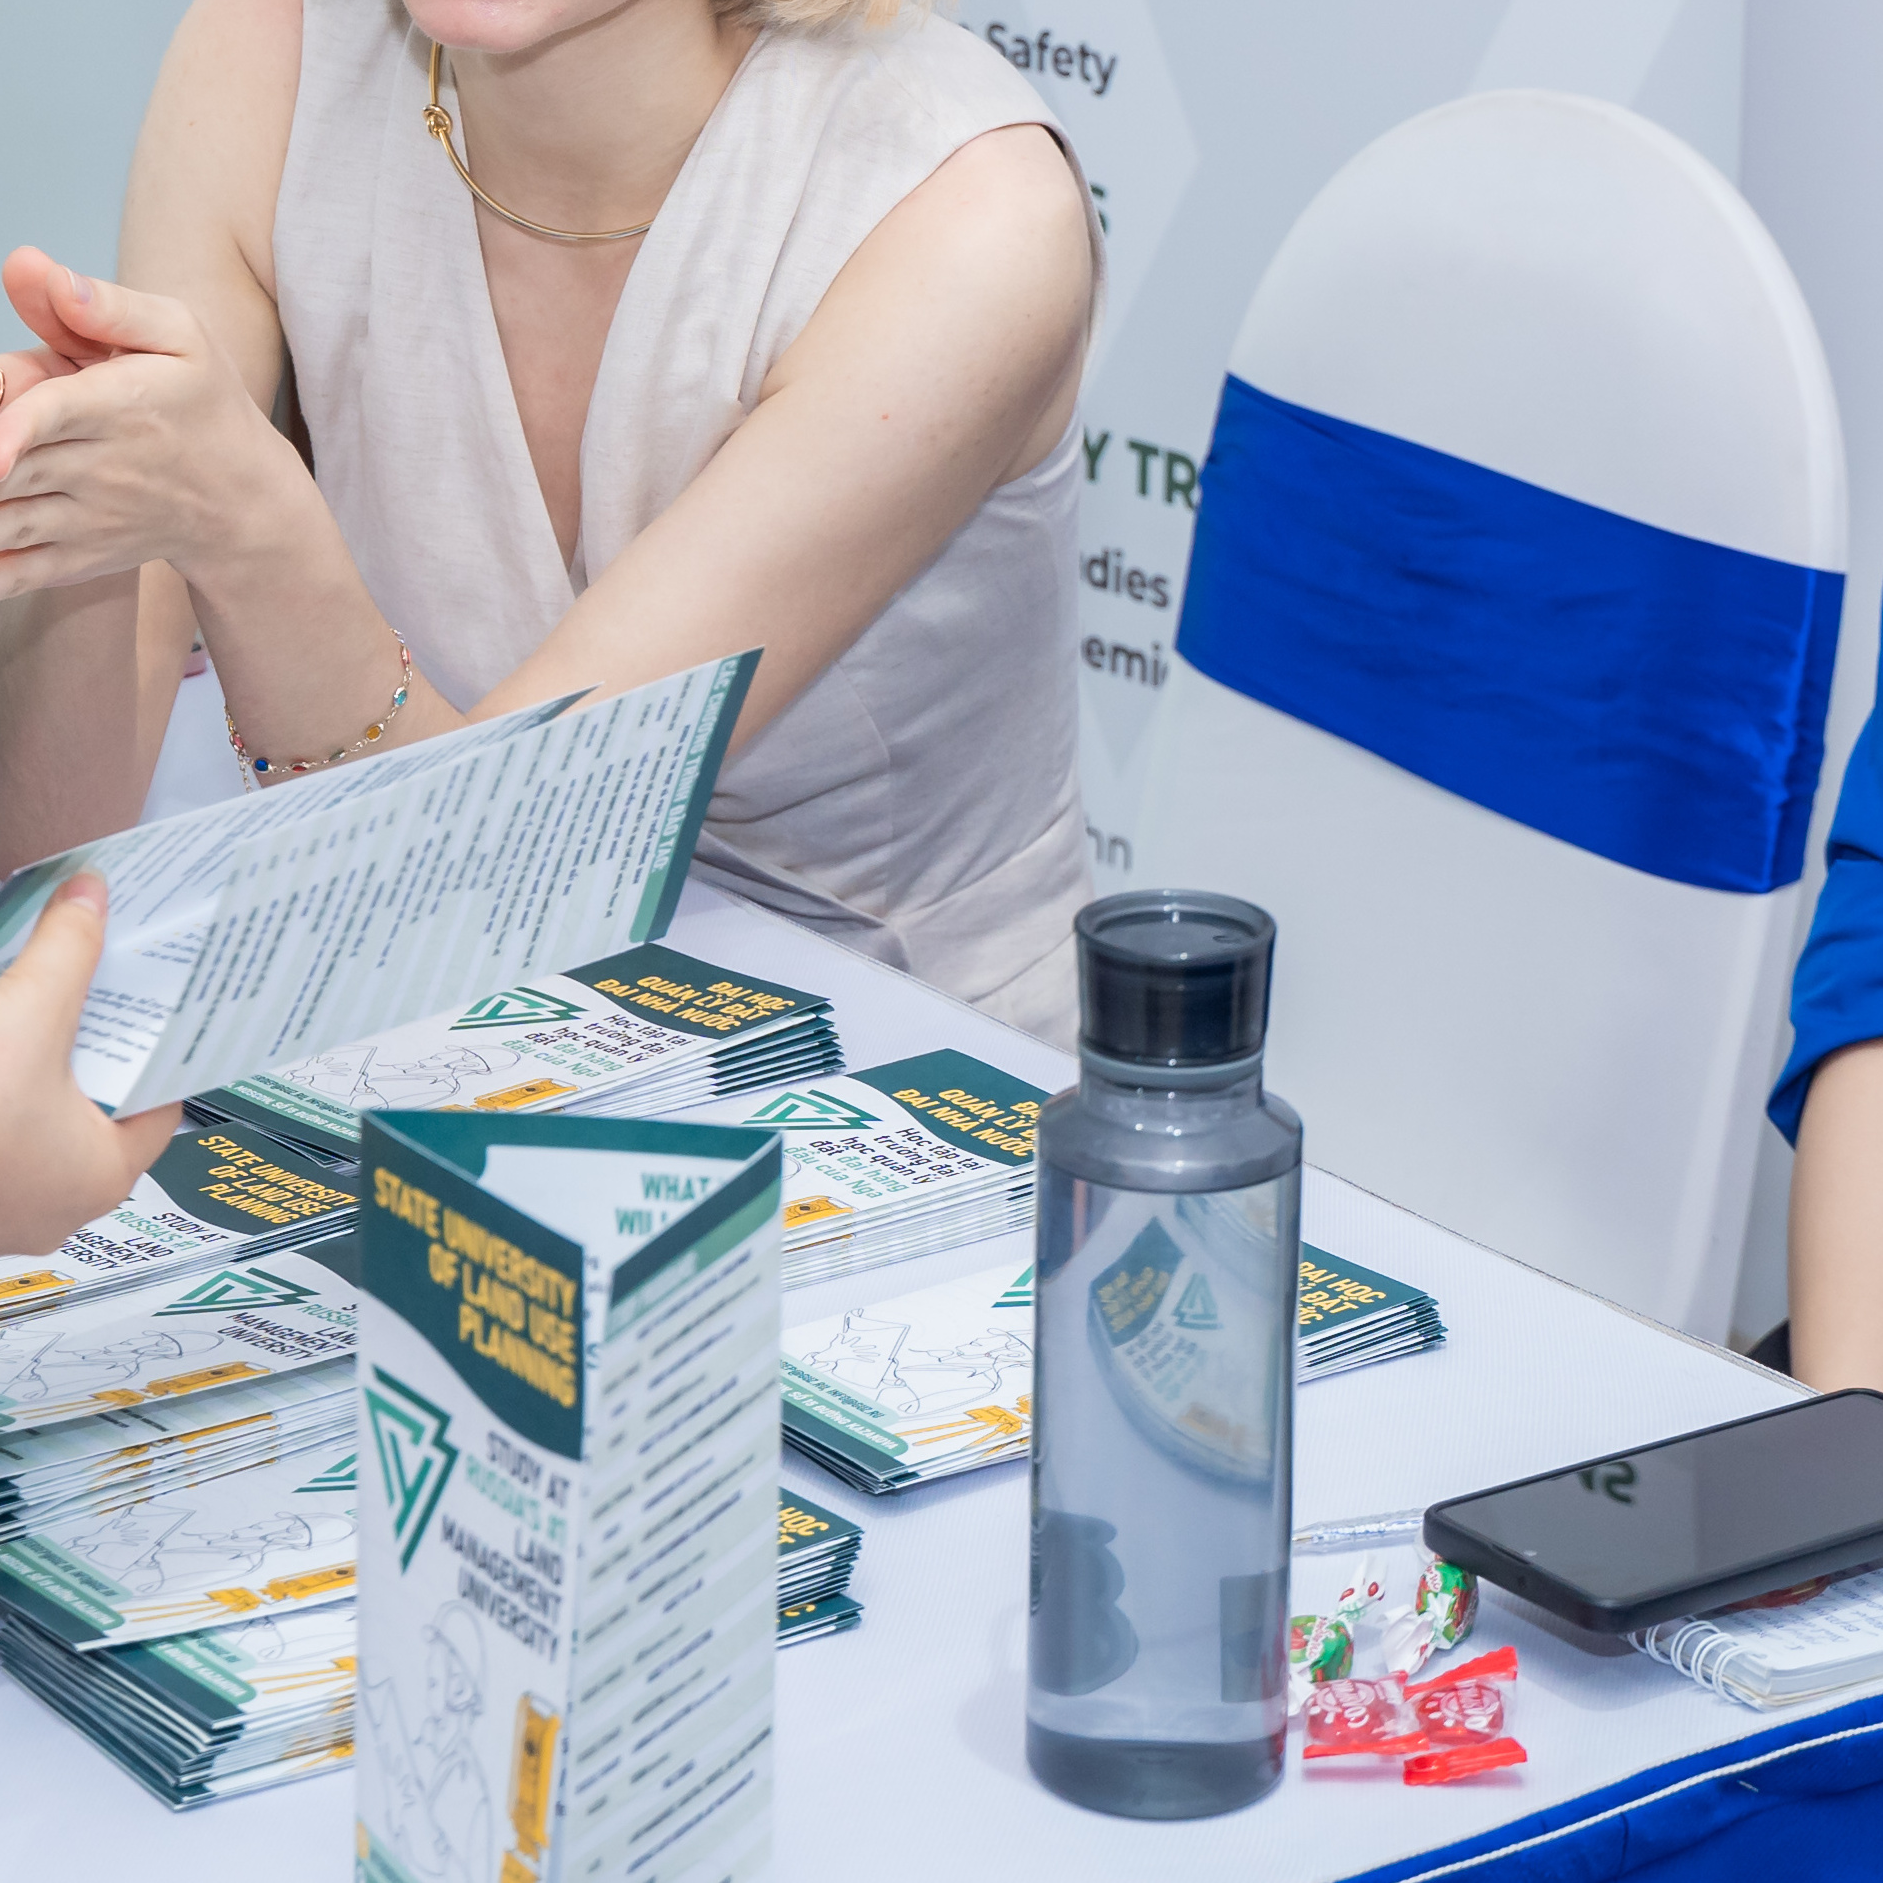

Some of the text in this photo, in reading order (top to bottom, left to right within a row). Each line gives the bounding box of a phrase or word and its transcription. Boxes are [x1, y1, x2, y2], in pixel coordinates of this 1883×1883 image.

[986, 22, 1118, 97] Safety
[564, 1062, 603, 1079] Nga
[1010, 1100, 1039, 1123] ĐẠ
[197, 1134, 361, 1207] STATE UNIVERSITY
[847, 1178, 884, 1199] Nga
[198, 1182, 301, 1224] PLANNING
[207, 1165, 332, 1216] OF LAND USE
[70, 1227, 150, 1265] AGEMENT
[109, 1210, 202, 1251] RUSSIA'S #1
[122, 1236, 174, 1258] LAND
[151, 1212, 230, 1243] STUDY AT
[373, 1166, 441, 1240] STATE
[442, 1205, 578, 1318] UNIVERSITY
[61, 1239, 124, 1270] VERSITY
[297, 1303, 359, 1330] RUSSIA
[428, 1241, 460, 1290] OF
[461, 1261, 527, 1332] LAND
[528, 1301, 578, 1366] USE
[217, 1325, 320, 1361] UNIVERSITY
[225, 1311, 346, 1353] MANAGEMENT
[458, 1302, 578, 1409] PLANNING
